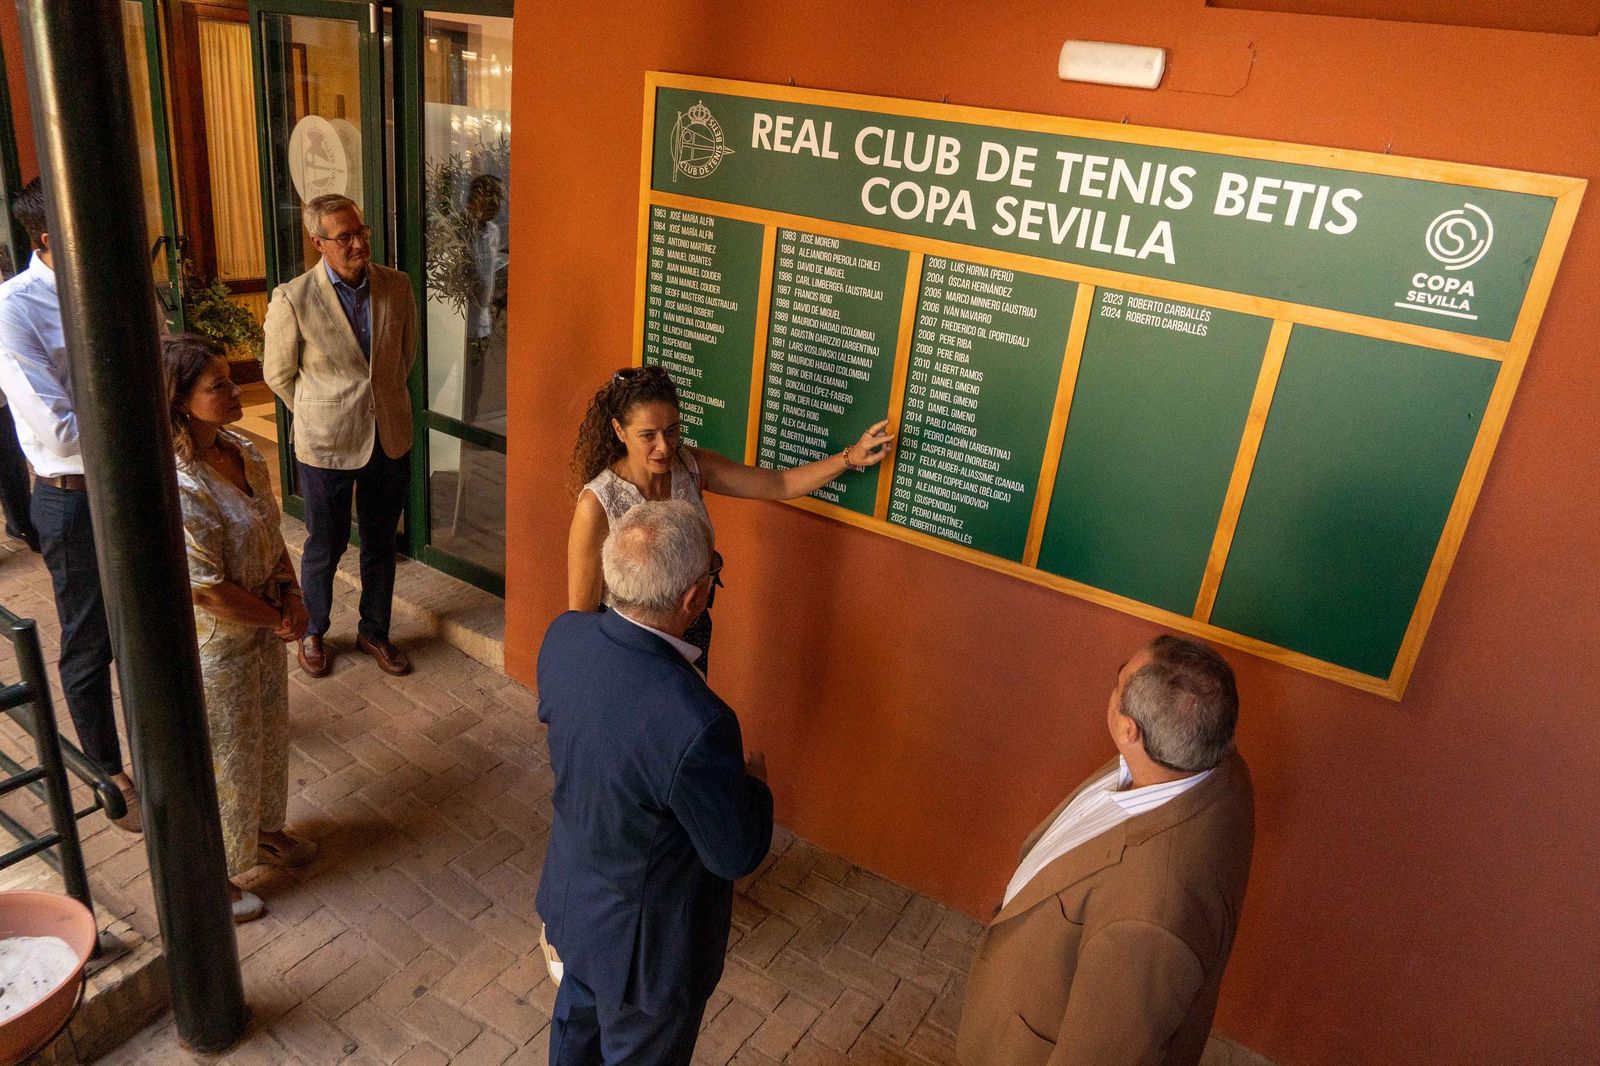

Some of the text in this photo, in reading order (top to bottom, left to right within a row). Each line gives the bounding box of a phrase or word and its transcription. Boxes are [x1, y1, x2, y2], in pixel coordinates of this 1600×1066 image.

[680, 119, 722, 175] CLUB DE TENIS BETIS
[751, 112, 1363, 235] REAL CLUB DE TENIS BETIS
[861, 177, 1176, 265] COPA SEVILLA
[782, 230, 839, 248] 1983 JOSÉ MORENO
[780, 257, 846, 278] 1985 DAVID DE MIGUEL
[781, 244, 795, 254] 1984
[799, 247, 832, 261] ALEJANDRO
[858, 258, 881, 271] (CHILE)
[929, 257, 1015, 282] 2003 LUIS HORNA (PERÚ)
[777, 284, 833, 303] 1987 FRANCIS ROIG
[779, 271, 883, 300] 1986 CARL (AUSTRALIA)
[927, 272, 1013, 297] 2004 ÓSCAR HERNÁNDEZ
[1412, 272, 1475, 297] COPA
[922, 301, 940, 313] 2006
[960, 309, 992, 323] NAVARRO
[924, 287, 942, 298] 2005
[946, 291, 970, 304] MARCO
[1001, 302, 1037, 318] (AUSTRIA)
[1102, 292, 1212, 321] 2023 ROBERTO CARBALLÉS
[1406, 290, 1471, 311] SEVILLA
[774, 324, 787, 334] 1990
[775, 311, 789, 321] 1989
[792, 314, 819, 328] MAURICIO
[840, 325, 875, 340] (COLOMBIA)
[920, 315, 1030, 347] 2007 FREDERICO GIL (PORTUGAL)
[1101, 306, 1209, 336] 2024 ROBERTO CARBALLÉS
[918, 329, 972, 349] 2008 PERE RIBA
[772, 337, 785, 347] 1991
[789, 340, 803, 351] LARS
[838, 352, 873, 368] (ALEMANIA)
[916, 343, 970, 363] 2009 PERE RIBA
[770, 362, 783, 372] 1993
[800, 370, 813, 380] DIER
[814, 373, 848, 388] (ALEMANIA)
[914, 357, 983, 381] 2010 ALBERT RAMOS
[769, 375, 782, 385] 1994
[785, 379, 811, 392] GONZALO
[912, 370, 980, 394] 2011 DANIEL GIMENO
[910, 384, 978, 408] 2012 DANIEL GIMENO
[906, 410, 922, 422] 2014
[926, 416, 946, 428] PABLO
[908, 397, 976, 422] 2013 DANIEL GIMENO
[764, 424, 827, 448] 1998 ALBERTO MARTÍN
[765, 412, 829, 436] 1997 ALEX CALATRAVA
[763, 436, 776, 446] 1999
[904, 424, 1011, 459] 2015 PEDRO CACHÍN (ARGENTINA)
[761, 447, 775, 458] 2000
[778, 453, 799, 465] TOMMY
[900, 450, 916, 461] 2017
[920, 455, 937, 467] FELIX
[938, 461, 994, 483] AUGER-ALIASSIME
[902, 437, 1000, 471] 2016 CASPER RUUD (NORUEGA)
[896, 475, 989, 509] 2019 ALEJANDRO DAVIDOVICH
[898, 462, 1012, 502] 2018 KIMMER COPPEJANS (BÉLGICA)
[894, 487, 957, 513] 2020 (SUSPENDIDA)
[893, 500, 964, 528] 2021 PEDRO MARTÍNEZ
[891, 512, 973, 544] 2022 ROBERTO CARBALLÉS
